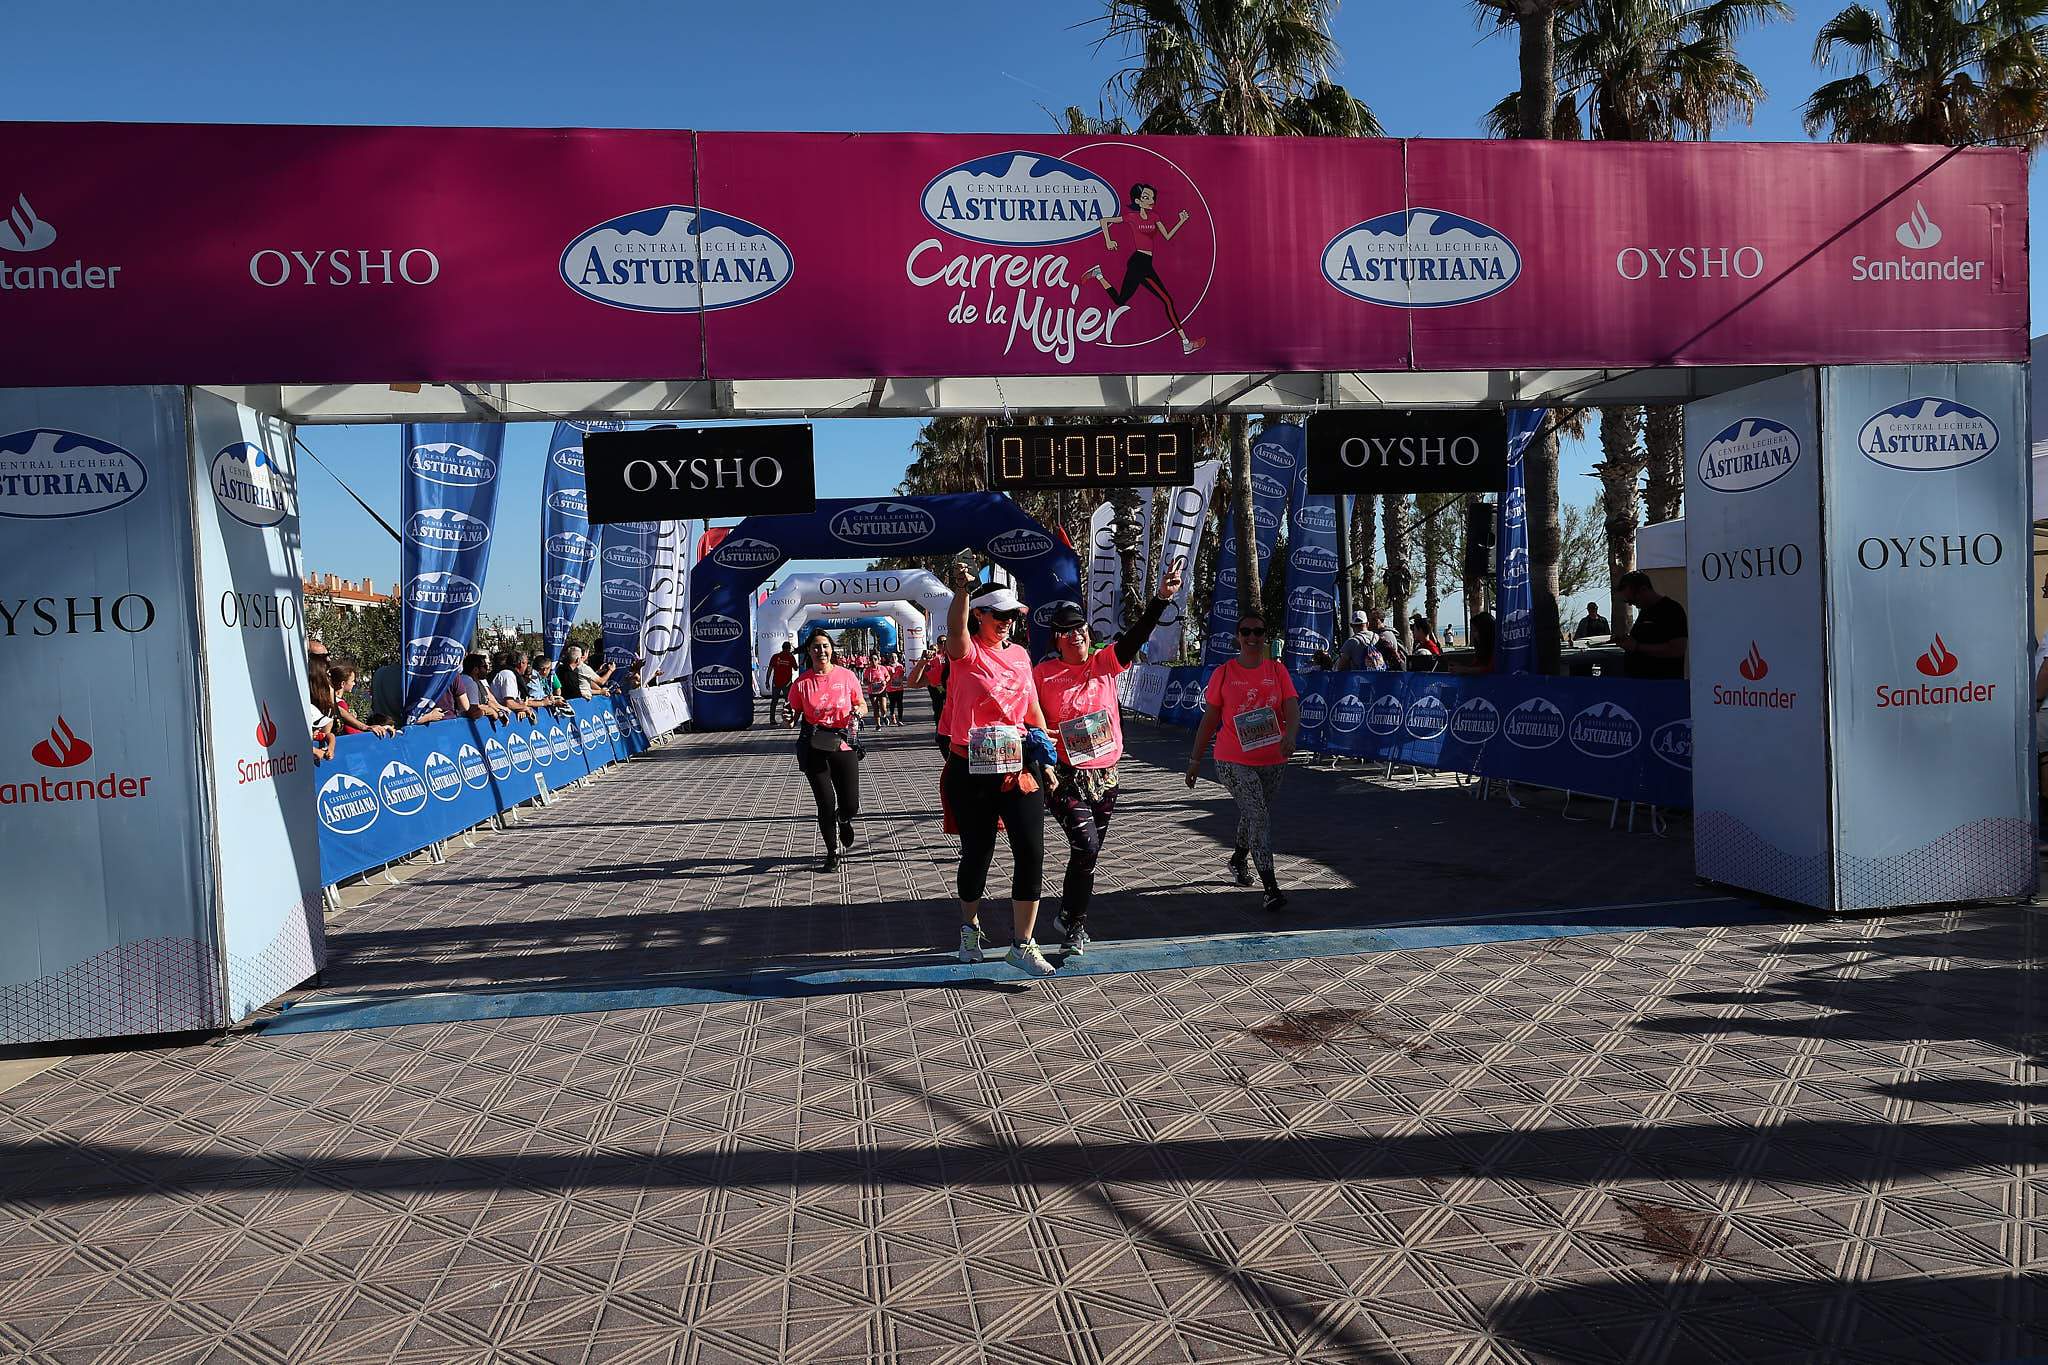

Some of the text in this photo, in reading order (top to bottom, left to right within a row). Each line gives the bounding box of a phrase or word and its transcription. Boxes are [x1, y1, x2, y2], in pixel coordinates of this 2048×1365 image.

[967, 184, 1098, 193] CENTRAL LECHERA
[937, 185, 1104, 221] ASTURIANA
[614, 243, 687, 253] CENTRAL
[1367, 242, 1499, 252] CENTRAL LECHERA
[0, 260, 120, 289] tander
[249, 248, 440, 287] OYSHO
[579, 245, 778, 285] ASTURIANA
[906, 238, 1073, 288] Carrera
[1338, 245, 1507, 282] ASTURIANA
[1616, 246, 1764, 280] OYSHO
[1852, 256, 1985, 281] Santander
[948, 284, 1131, 364] de la Mujer
[1889, 421, 1984, 432] CENTRAL LECHERA
[1340, 436, 1480, 468] OYSHO
[1718, 435, 1789, 457] CENTRAL LECHERA
[1869, 426, 1988, 454] ASTURIANA
[0, 459, 125, 470] ENTRAL LECHERA
[412, 452, 491, 479] ASTURIANA
[1002, 434, 1177, 479] 01:00:52
[1256, 447, 1292, 466] ASTURIANA
[1704, 445, 1792, 480] ASTURIANA
[0, 471, 133, 496] TURIANA
[623, 456, 783, 492] OYSHO
[218, 464, 285, 511] ASTURIANA
[411, 520, 483, 542] ASTURIANA
[838, 517, 928, 535] ASTURIANA
[606, 550, 648, 566] ASTURIANA
[717, 550, 775, 561] ASTURIANA
[993, 541, 1049, 552] ASTURIANA
[1857, 533, 2003, 571] OYSHO
[1702, 543, 1802, 582] OYSHO
[409, 585, 474, 604] ASTURIANA
[820, 576, 901, 595] OYSHO
[221, 590, 297, 630] OYSHO
[604, 621, 639, 631] STURIANA
[695, 625, 740, 637] ASTURIANA
[696, 675, 741, 687] ASTURIANA
[1713, 685, 1797, 709] Santander
[1877, 681, 1996, 708] Santander
[1332, 709, 1361, 724] ASTURIANA
[1368, 708, 1400, 726] ASTURIANA
[1407, 710, 1444, 729] ASTURIANA
[1453, 714, 1495, 733] ASTURIANA
[1507, 716, 1559, 738] ASTURIANA
[1573, 720, 1633, 747] ASTURIANA
[237, 752, 298, 785] Santander
[0, 773, 152, 805] antander
[428, 772, 460, 792] ASTURIANA
[383, 783, 426, 806] ASTURIANA
[323, 797, 377, 825] ASTURIANA
